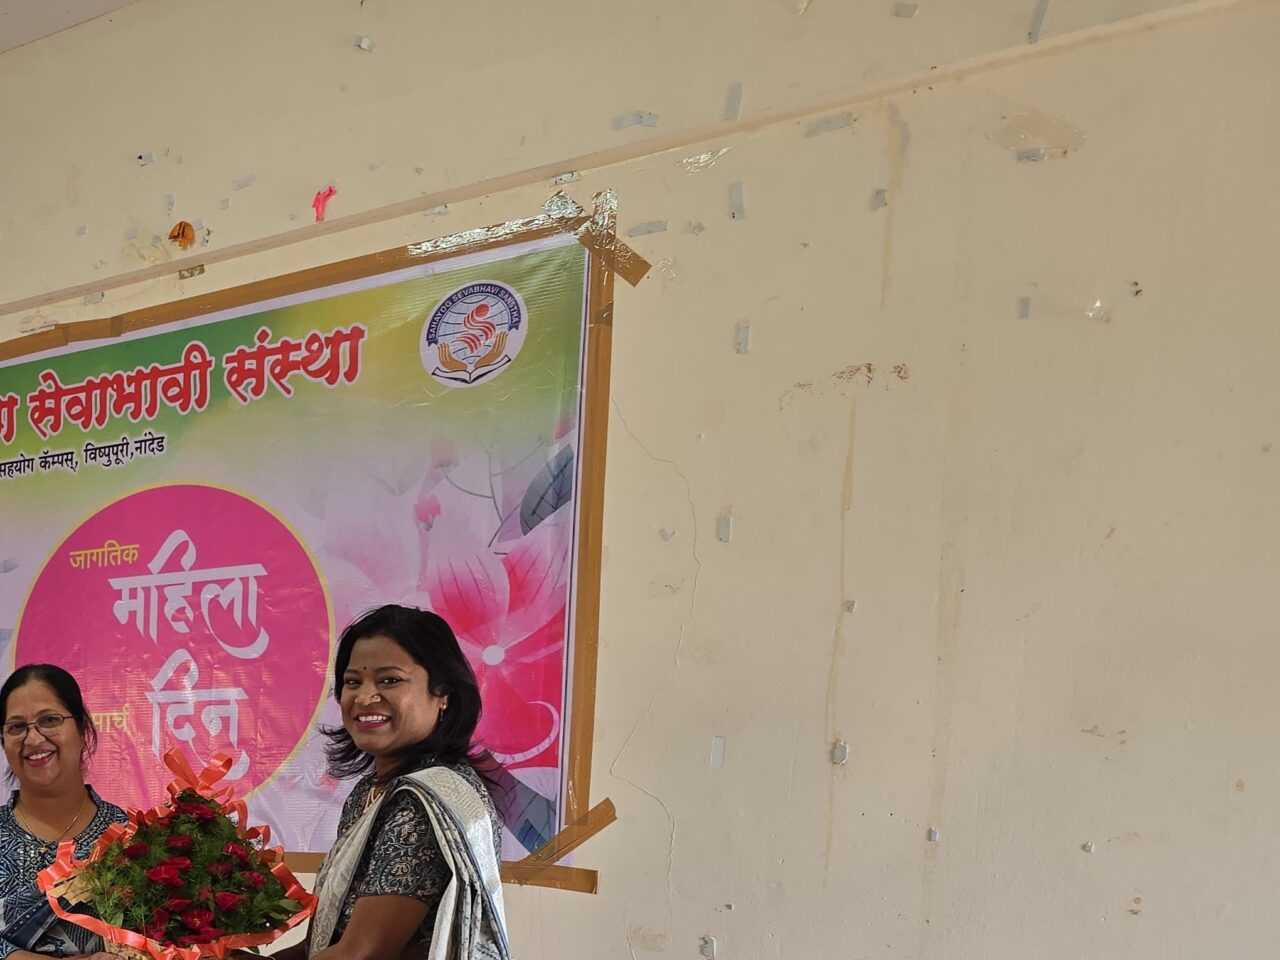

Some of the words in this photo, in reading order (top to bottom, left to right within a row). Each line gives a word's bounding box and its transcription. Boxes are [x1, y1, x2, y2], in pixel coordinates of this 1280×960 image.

[428, 300, 453, 339] SAHAYOG
[453, 285, 499, 302] SEVABHAVI
[499, 289, 520, 325] SANSTHA
[27, 343, 214, 438] सेवाभावी
[225, 326, 366, 403] संस्था
[69, 539, 140, 570] जागतिक
[107, 529, 270, 660] महिला
[144, 648, 250, 781] दिन
